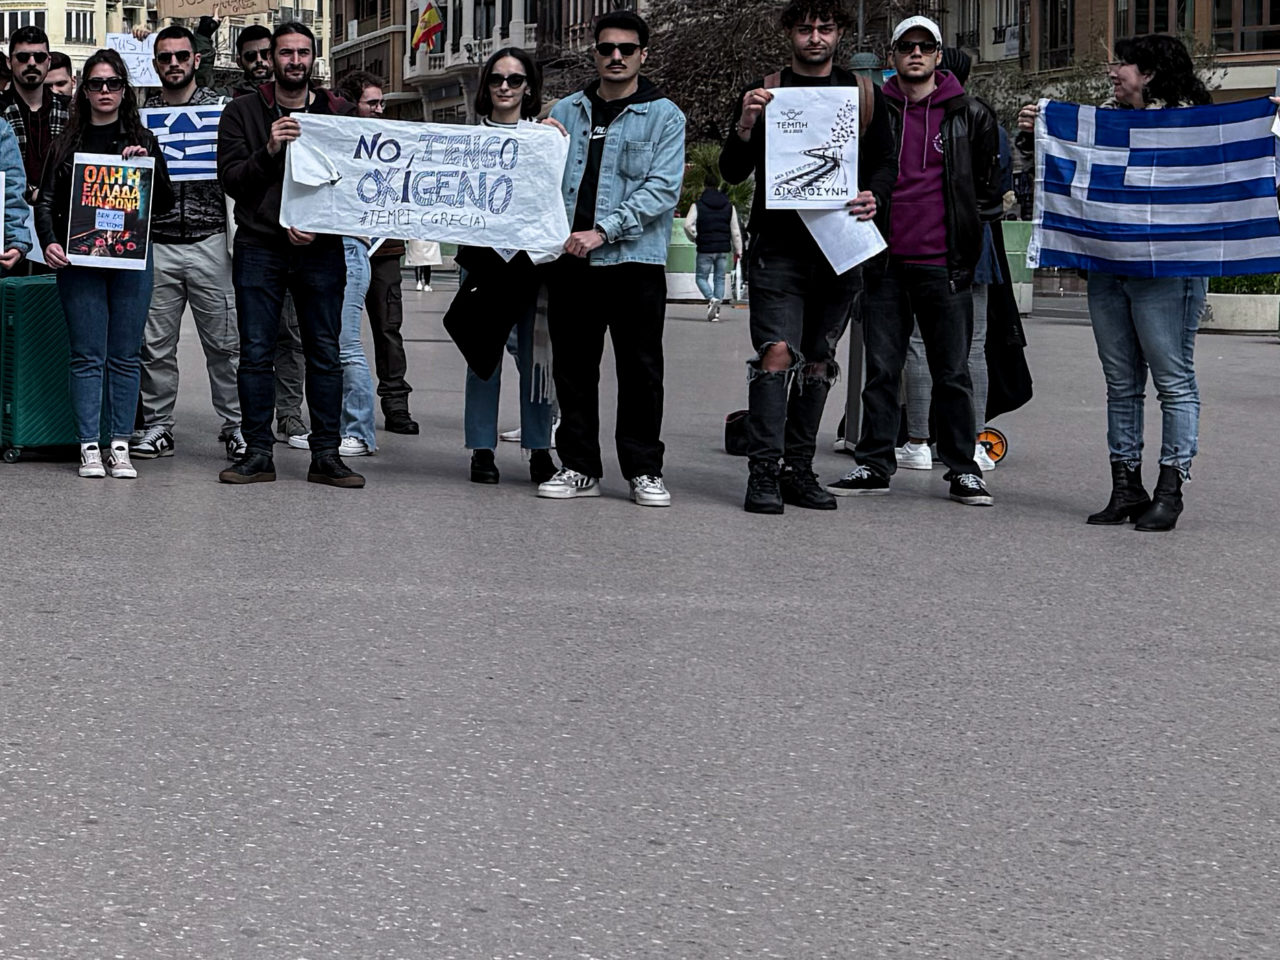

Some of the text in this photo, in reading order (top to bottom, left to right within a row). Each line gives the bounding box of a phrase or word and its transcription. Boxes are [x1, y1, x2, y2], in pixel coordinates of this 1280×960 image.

[776, 121, 808, 129] ΤΕΜΠΗ
[353, 132, 519, 170] NO TENGO
[83, 165, 141, 186] ΟΛΗ Η
[356, 154, 514, 215] OXÍGENO
[82, 182, 141, 199] ΕΛΛΑΔΑ
[773, 187, 849, 196] ΔΙΚΑΙΟΣΥΝΗ
[81, 195, 140, 211] ΜΙΑ ΦΩΝΗ
[358, 208, 416, 227] #TEMPI
